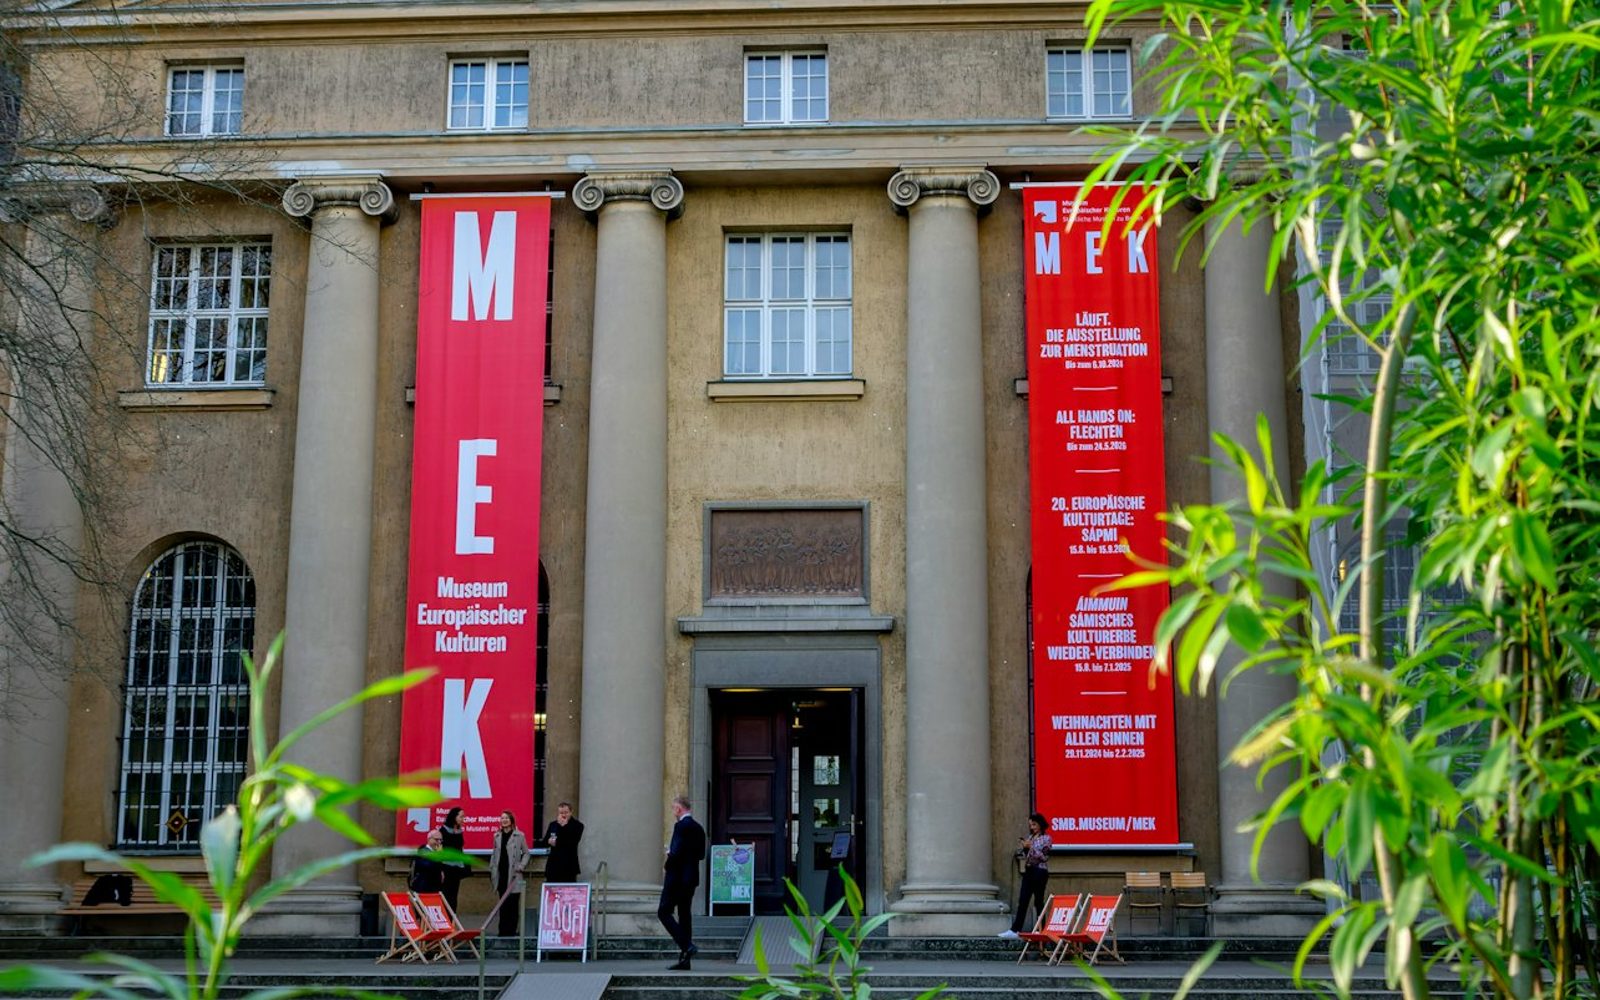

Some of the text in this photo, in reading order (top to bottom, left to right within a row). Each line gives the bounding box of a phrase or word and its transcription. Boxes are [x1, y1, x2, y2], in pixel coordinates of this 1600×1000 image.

[1076, 312, 1111, 326] LÄUFT.
[1046, 328, 1141, 342] DIE AUSSTELLUNG
[1040, 343, 1148, 358] ZUR MENSTRUATION
[1065, 360, 1076, 369] Bis
[1056, 409, 1136, 424] ALL HANDS ON:
[1070, 425, 1124, 439] FLECHTEN
[1067, 442, 1078, 451] Bis
[1052, 494, 1146, 510] 20. EUROPÄISCHE
[1064, 512, 1134, 526] KULTURTAGE:
[1082, 527, 1117, 542] SÁPMI
[1070, 545, 1086, 554] 15.8.
[1086, 545, 1097, 554] bis
[438, 576, 508, 598] Museum
[418, 603, 527, 630] Europäischer
[1070, 612, 1134, 628] SÁMISCHES
[436, 631, 507, 652] Kulturen
[1068, 630, 1136, 644] KULTURERBE
[1048, 645, 1156, 660] WIEDER-VERBINDEN
[1092, 663, 1102, 672] bis
[1104, 662, 1132, 672] 7.1.2025
[1052, 714, 1156, 730] WEIHNACHTEN MIT
[1065, 732, 1144, 746] ALLEN SINNEN
[1102, 748, 1114, 758] bis
[1115, 748, 1145, 758] 2.2.2025
[1052, 816, 1156, 832] SMB.MUSEUM/MEK
[732, 885, 750, 898] MEK
[541, 930, 562, 944] MEK
